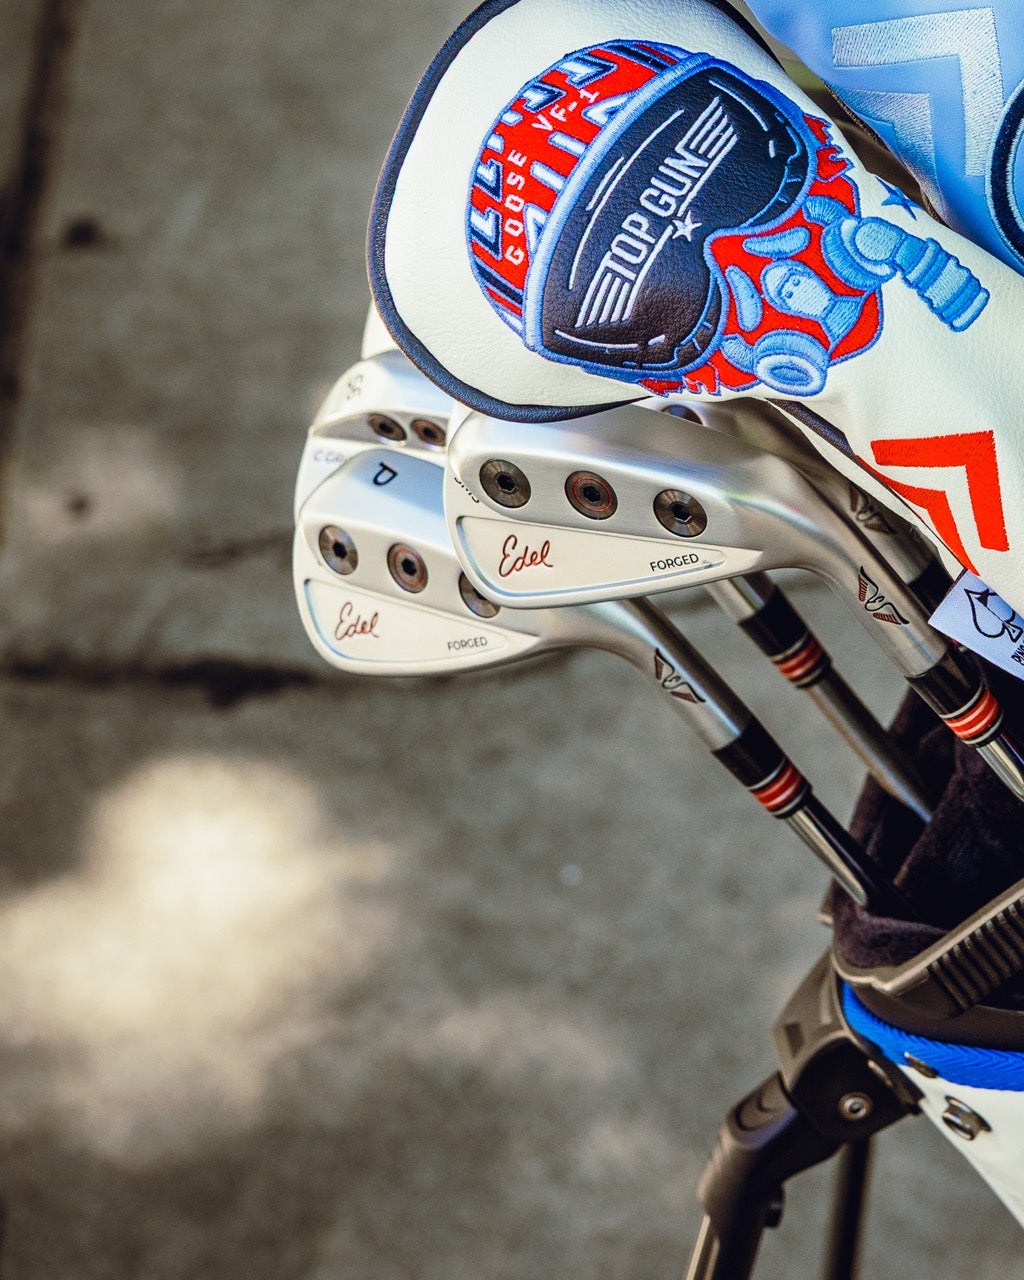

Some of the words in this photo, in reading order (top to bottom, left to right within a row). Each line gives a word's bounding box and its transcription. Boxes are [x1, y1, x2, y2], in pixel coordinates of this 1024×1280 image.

[503, 149, 528, 266] GOOSE
[532, 89, 600, 131] VF-1
[603, 212, 656, 281] TOP
[639, 147, 709, 217] GUN
[499, 534, 554, 578] Edel
[649, 553, 699, 572] FORGED
[334, 601, 380, 641] Edel
[447, 636, 488, 651] FORGED
